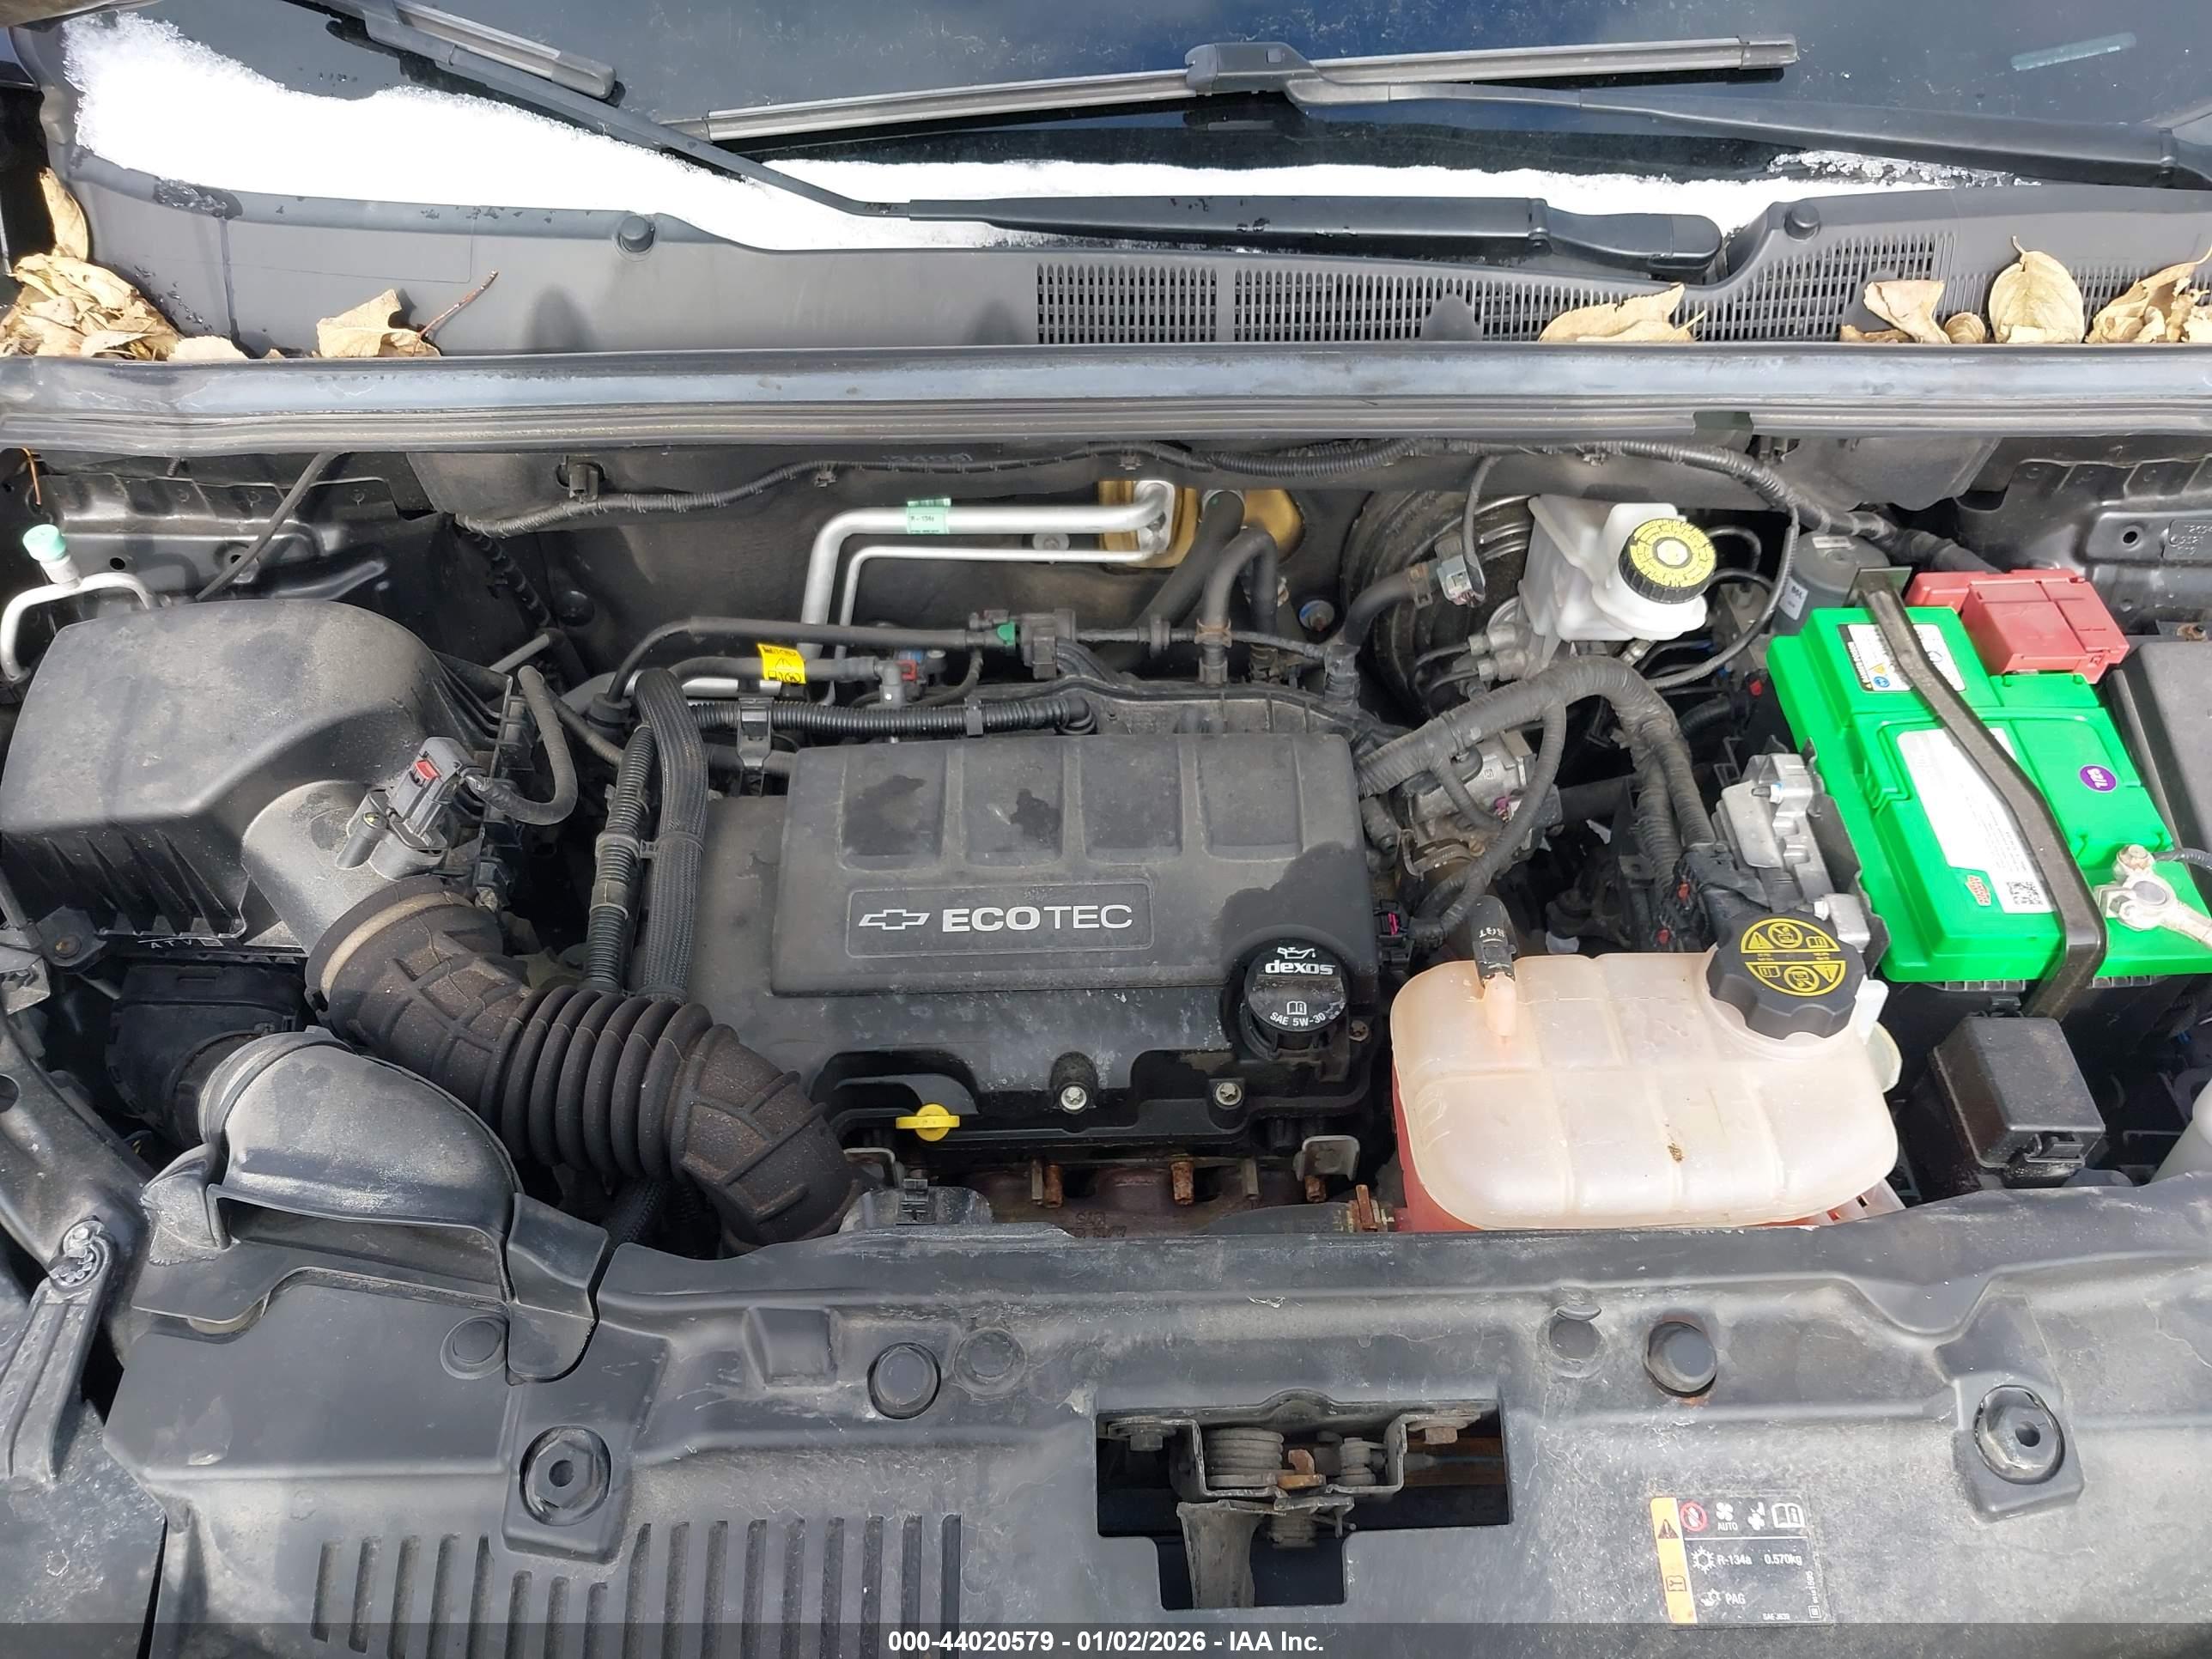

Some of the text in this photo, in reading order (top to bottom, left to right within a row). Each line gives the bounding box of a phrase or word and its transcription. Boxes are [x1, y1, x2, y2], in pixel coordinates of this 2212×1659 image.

[942, 904, 1133, 933] ECOTEC
[1265, 959, 1336, 975] dexos
[1269, 1012, 1326, 1027] SAE 5W-30
[1717, 1522, 1739, 1531] AUTO
[1717, 1553, 1802, 1566] R-134a 0.570kg
[1725, 1593, 1747, 1605] PAG
